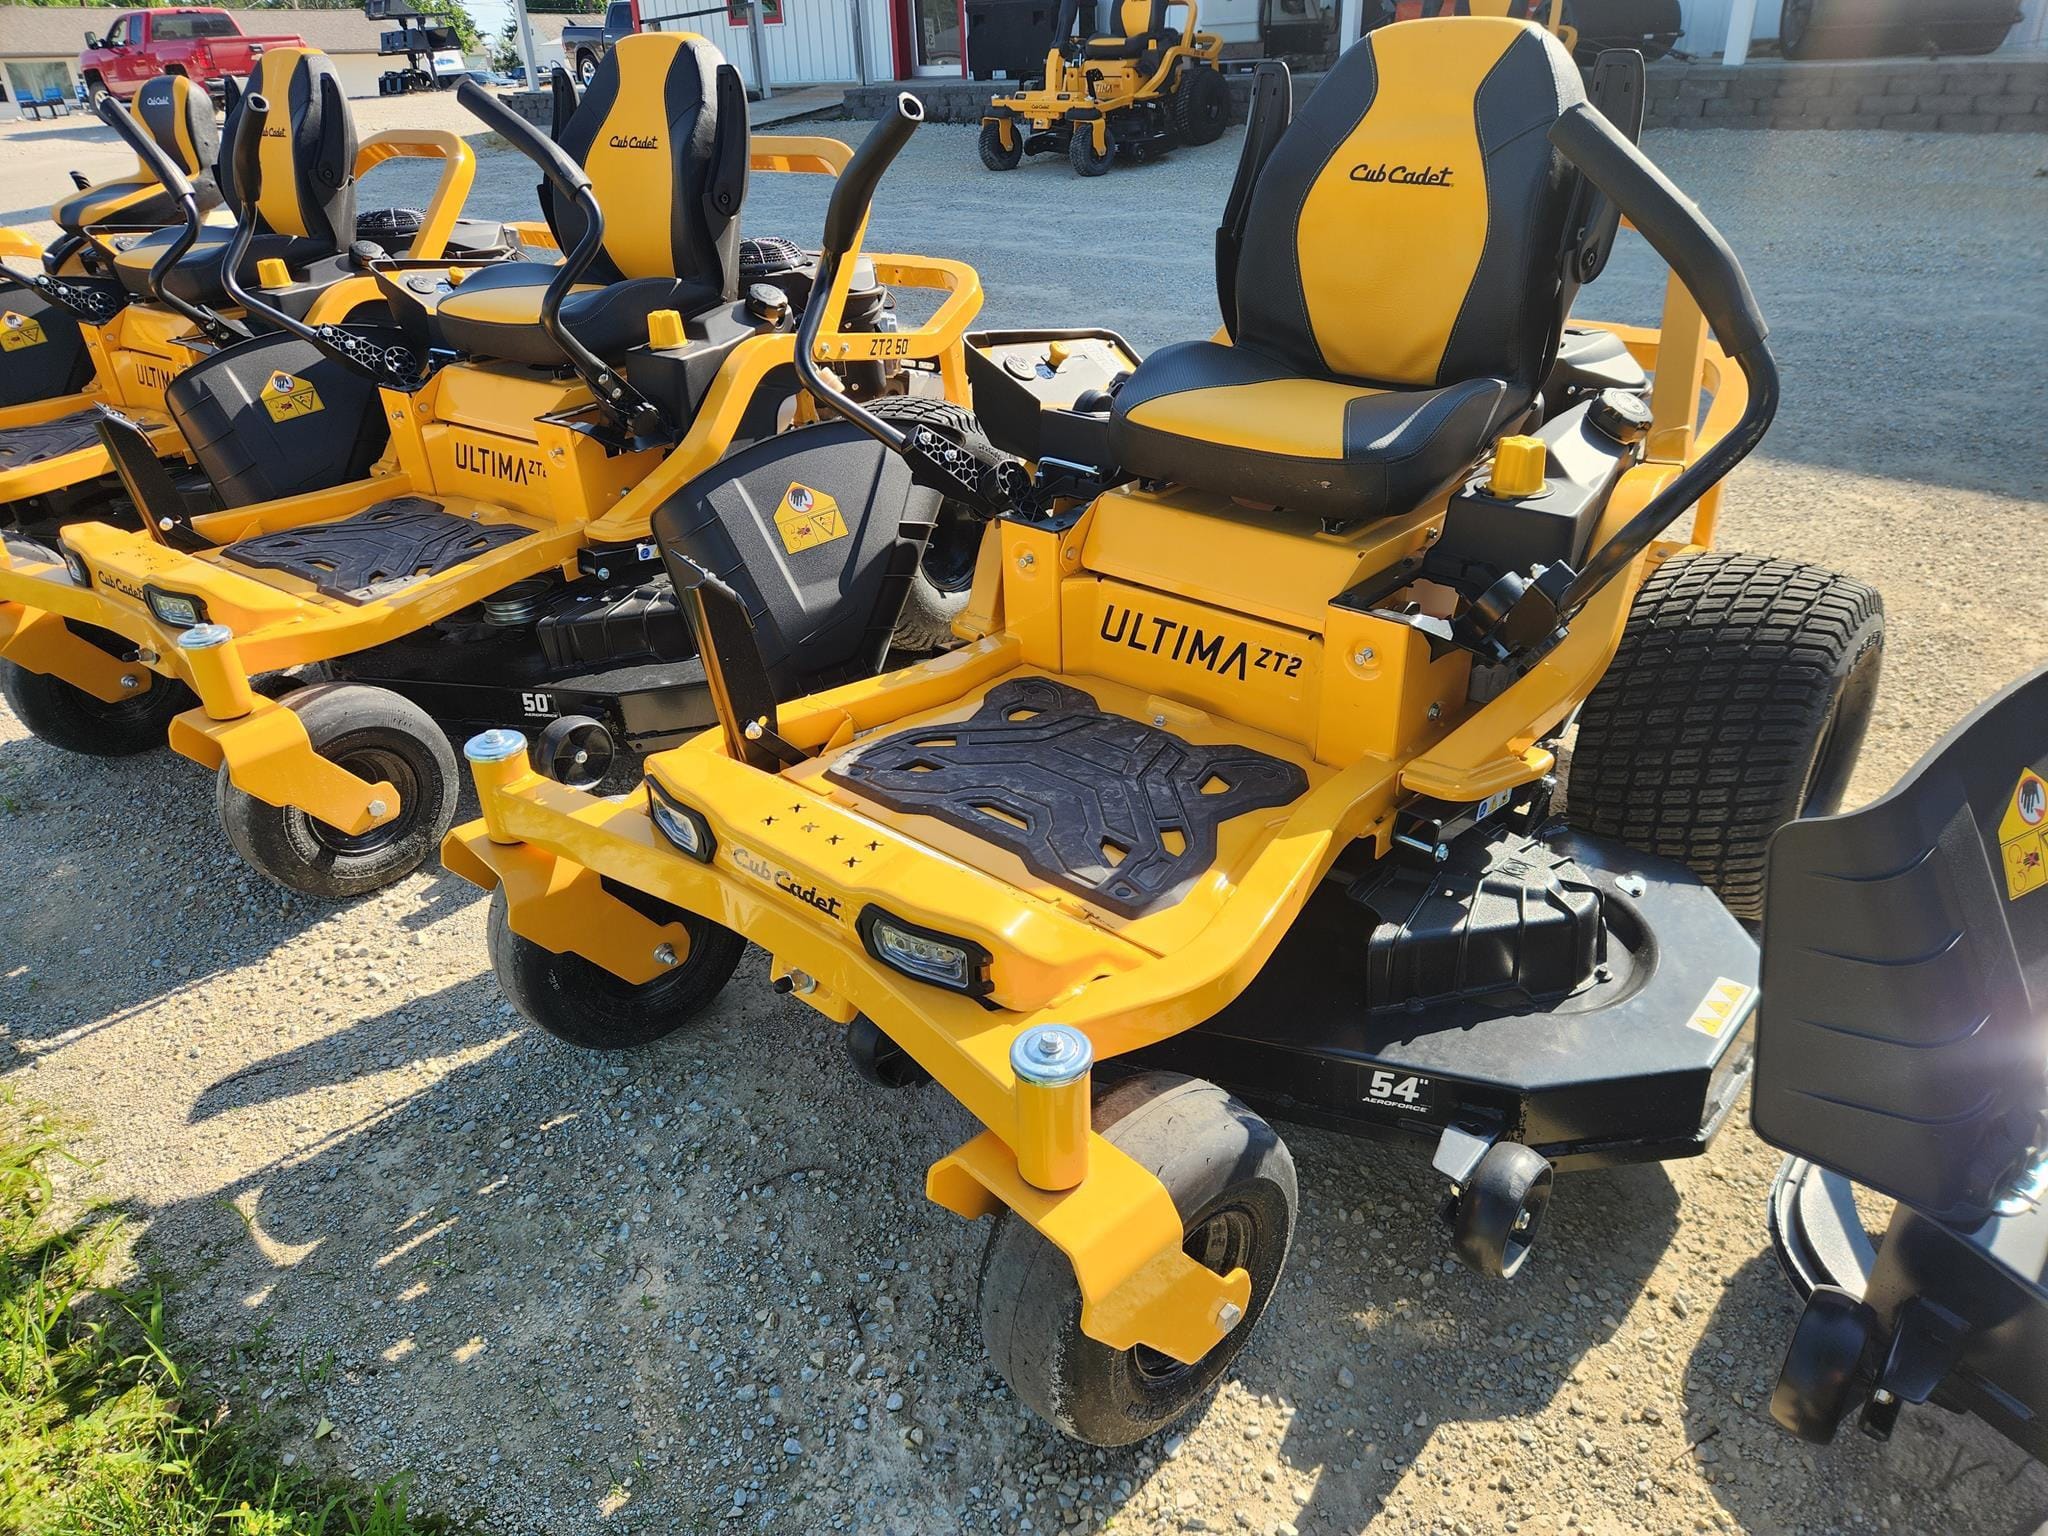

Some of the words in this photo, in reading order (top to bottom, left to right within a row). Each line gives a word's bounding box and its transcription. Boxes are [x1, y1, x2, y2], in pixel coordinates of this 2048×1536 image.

[610, 135, 628, 148] Cub
[629, 135, 659, 149] Cadet
[1350, 163, 1387, 183] Cub
[1388, 165, 1454, 187] Cadet
[870, 338, 892, 356] ZT2
[895, 338, 909, 355] 50
[455, 442, 528, 486] ULTIMA
[98, 570, 116, 589] Cub
[115, 578, 145, 602] Cadet
[1100, 604, 1248, 682] ULTIMA
[1254, 647, 1303, 678] ZT2
[521, 692, 552, 713] 50"
[733, 848, 772, 881] Cub
[774, 870, 842, 920] Cadet
[1369, 1070, 1429, 1103] 54"
[1362, 1096, 1428, 1113] AEROFORCE
